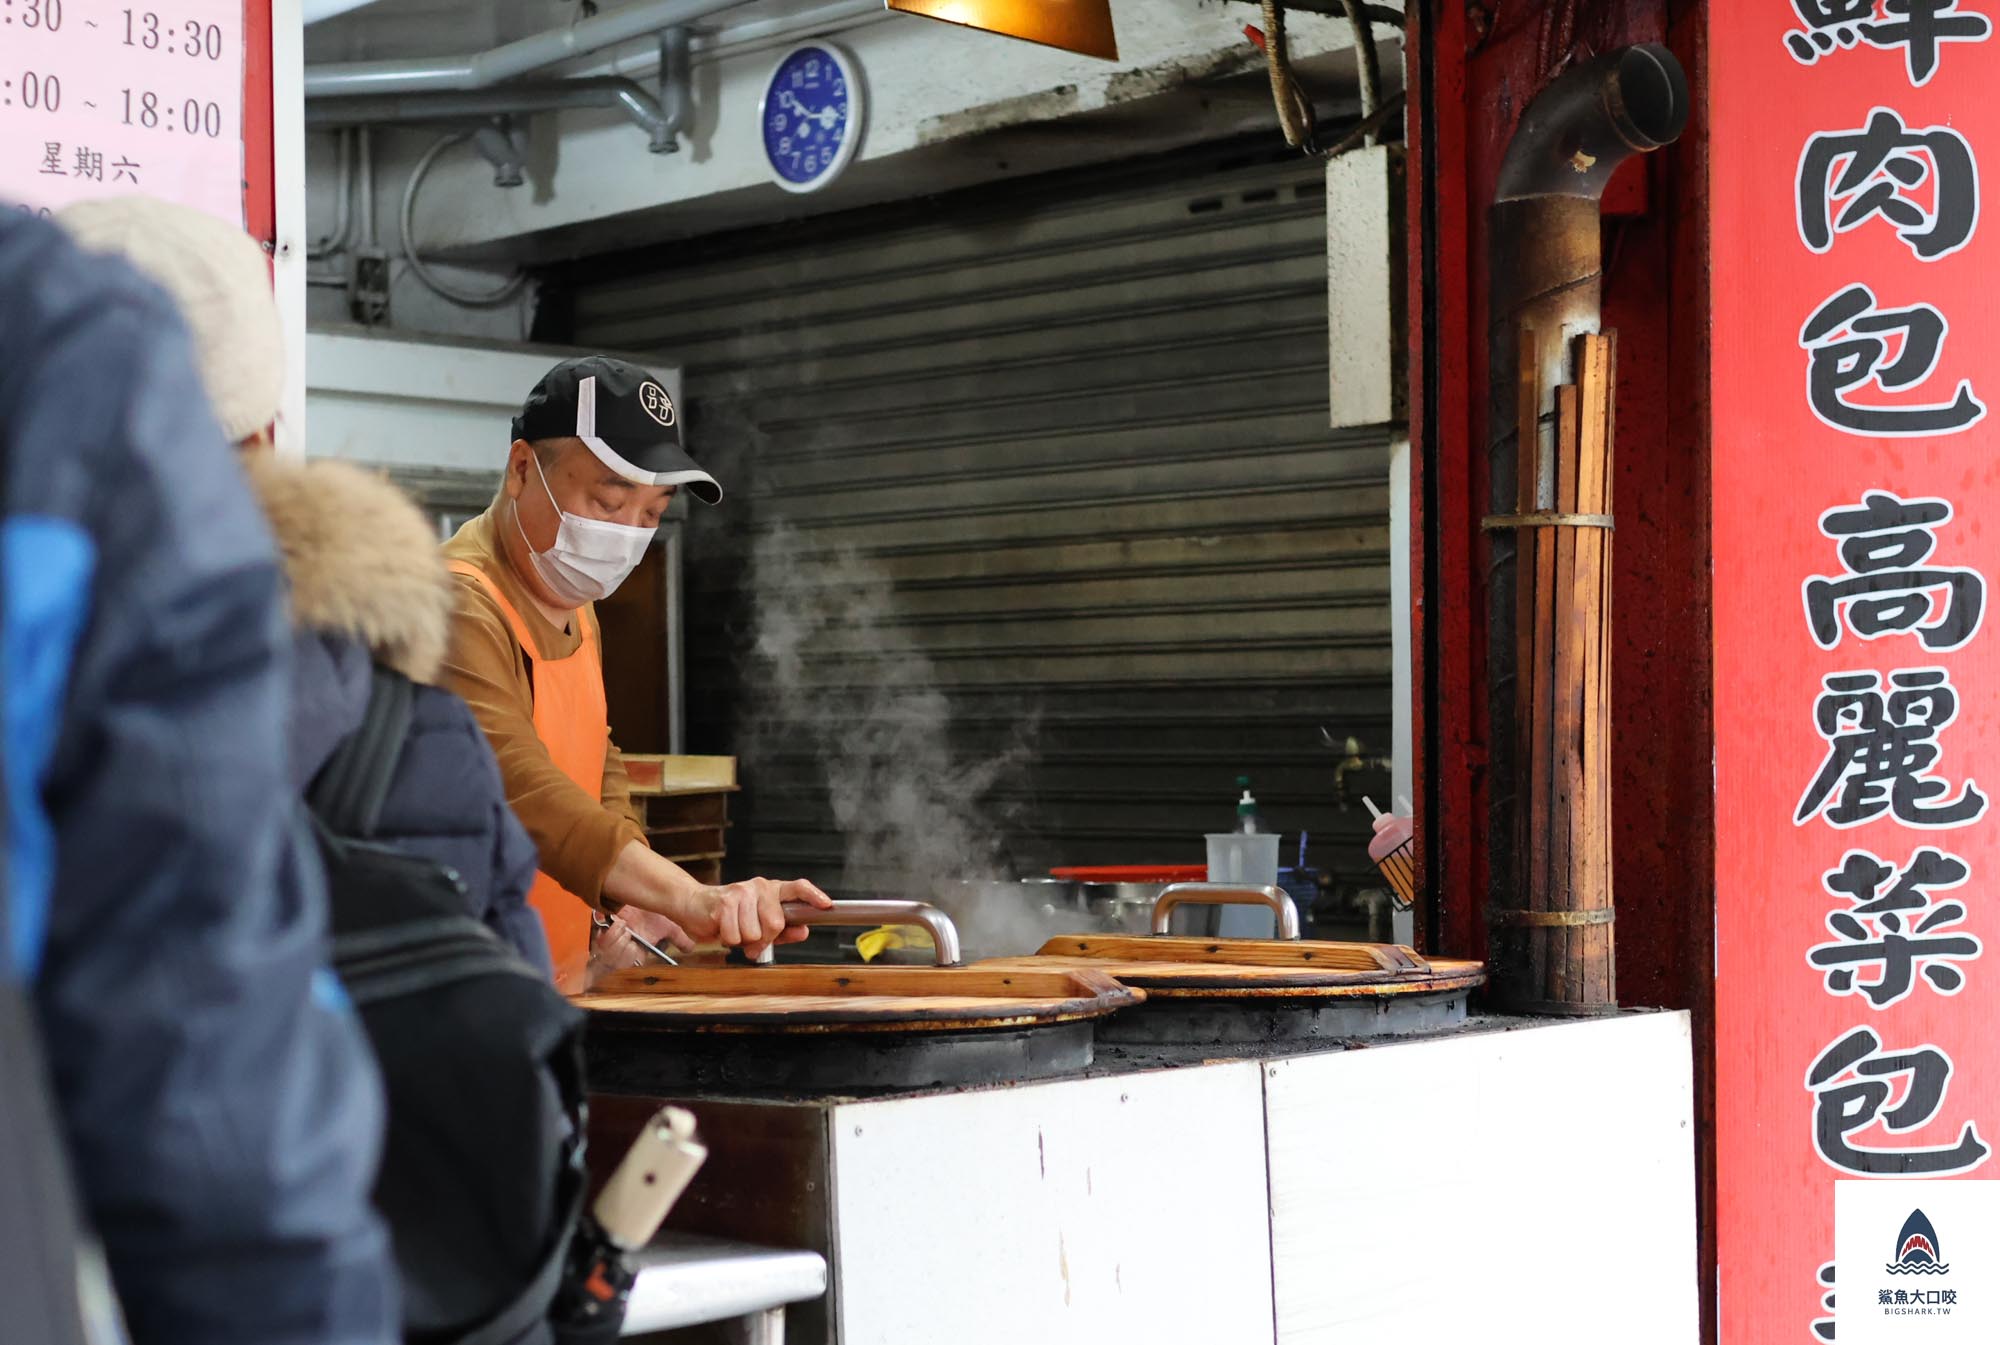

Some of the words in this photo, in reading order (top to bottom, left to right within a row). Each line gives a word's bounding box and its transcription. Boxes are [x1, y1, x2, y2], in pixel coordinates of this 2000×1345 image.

[121, 9, 222, 60] 13:30
[805, 60, 819, 77] 12
[776, 90, 795, 109] 10
[121, 88, 221, 137] 18:00
[774, 113, 788, 132] 9
[779, 136, 791, 155] 8
[38, 141, 140, 184] 星期六
[791, 151, 801, 168] 7
[804, 155, 817, 173] 6
[1797, 492, 1989, 1177] 高麗菜包
